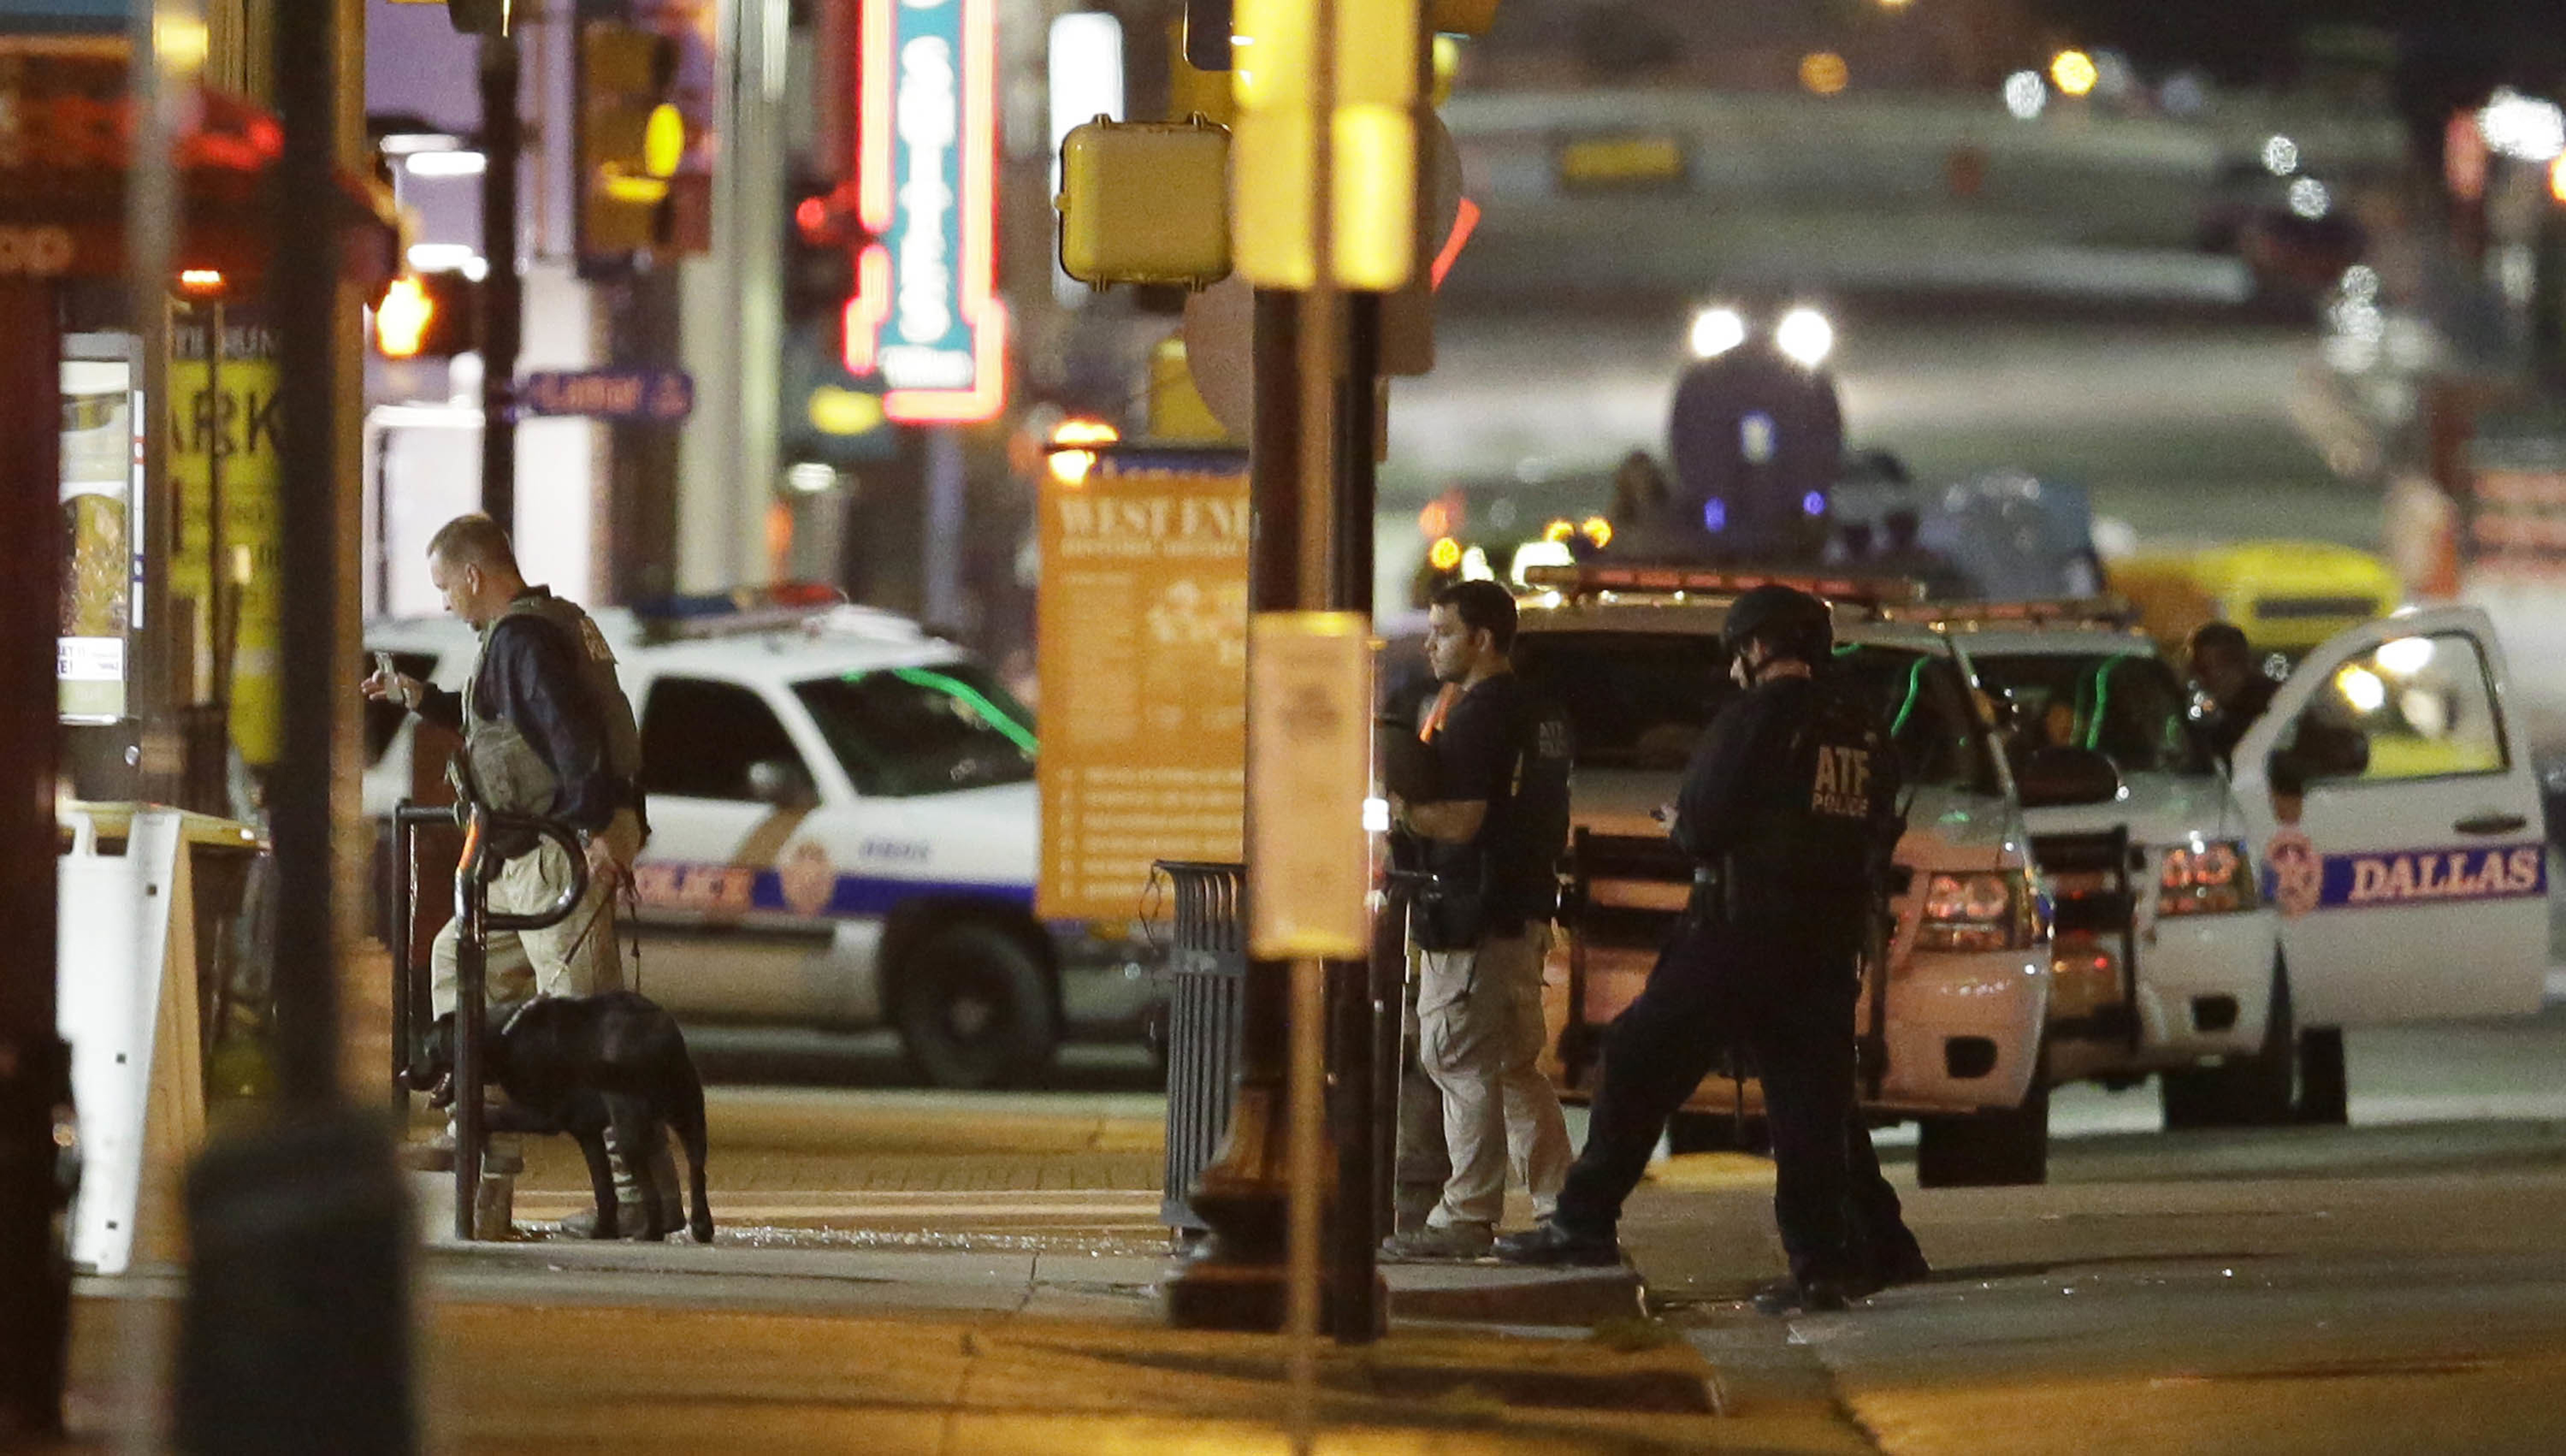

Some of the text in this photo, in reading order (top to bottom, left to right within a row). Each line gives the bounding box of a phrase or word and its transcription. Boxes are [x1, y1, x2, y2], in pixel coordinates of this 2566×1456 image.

[1815, 746, 1870, 795] ATF
[1812, 792, 1869, 817] POLICE
[635, 865, 753, 909] OLICE
[2348, 849, 2538, 902] DALLAS
